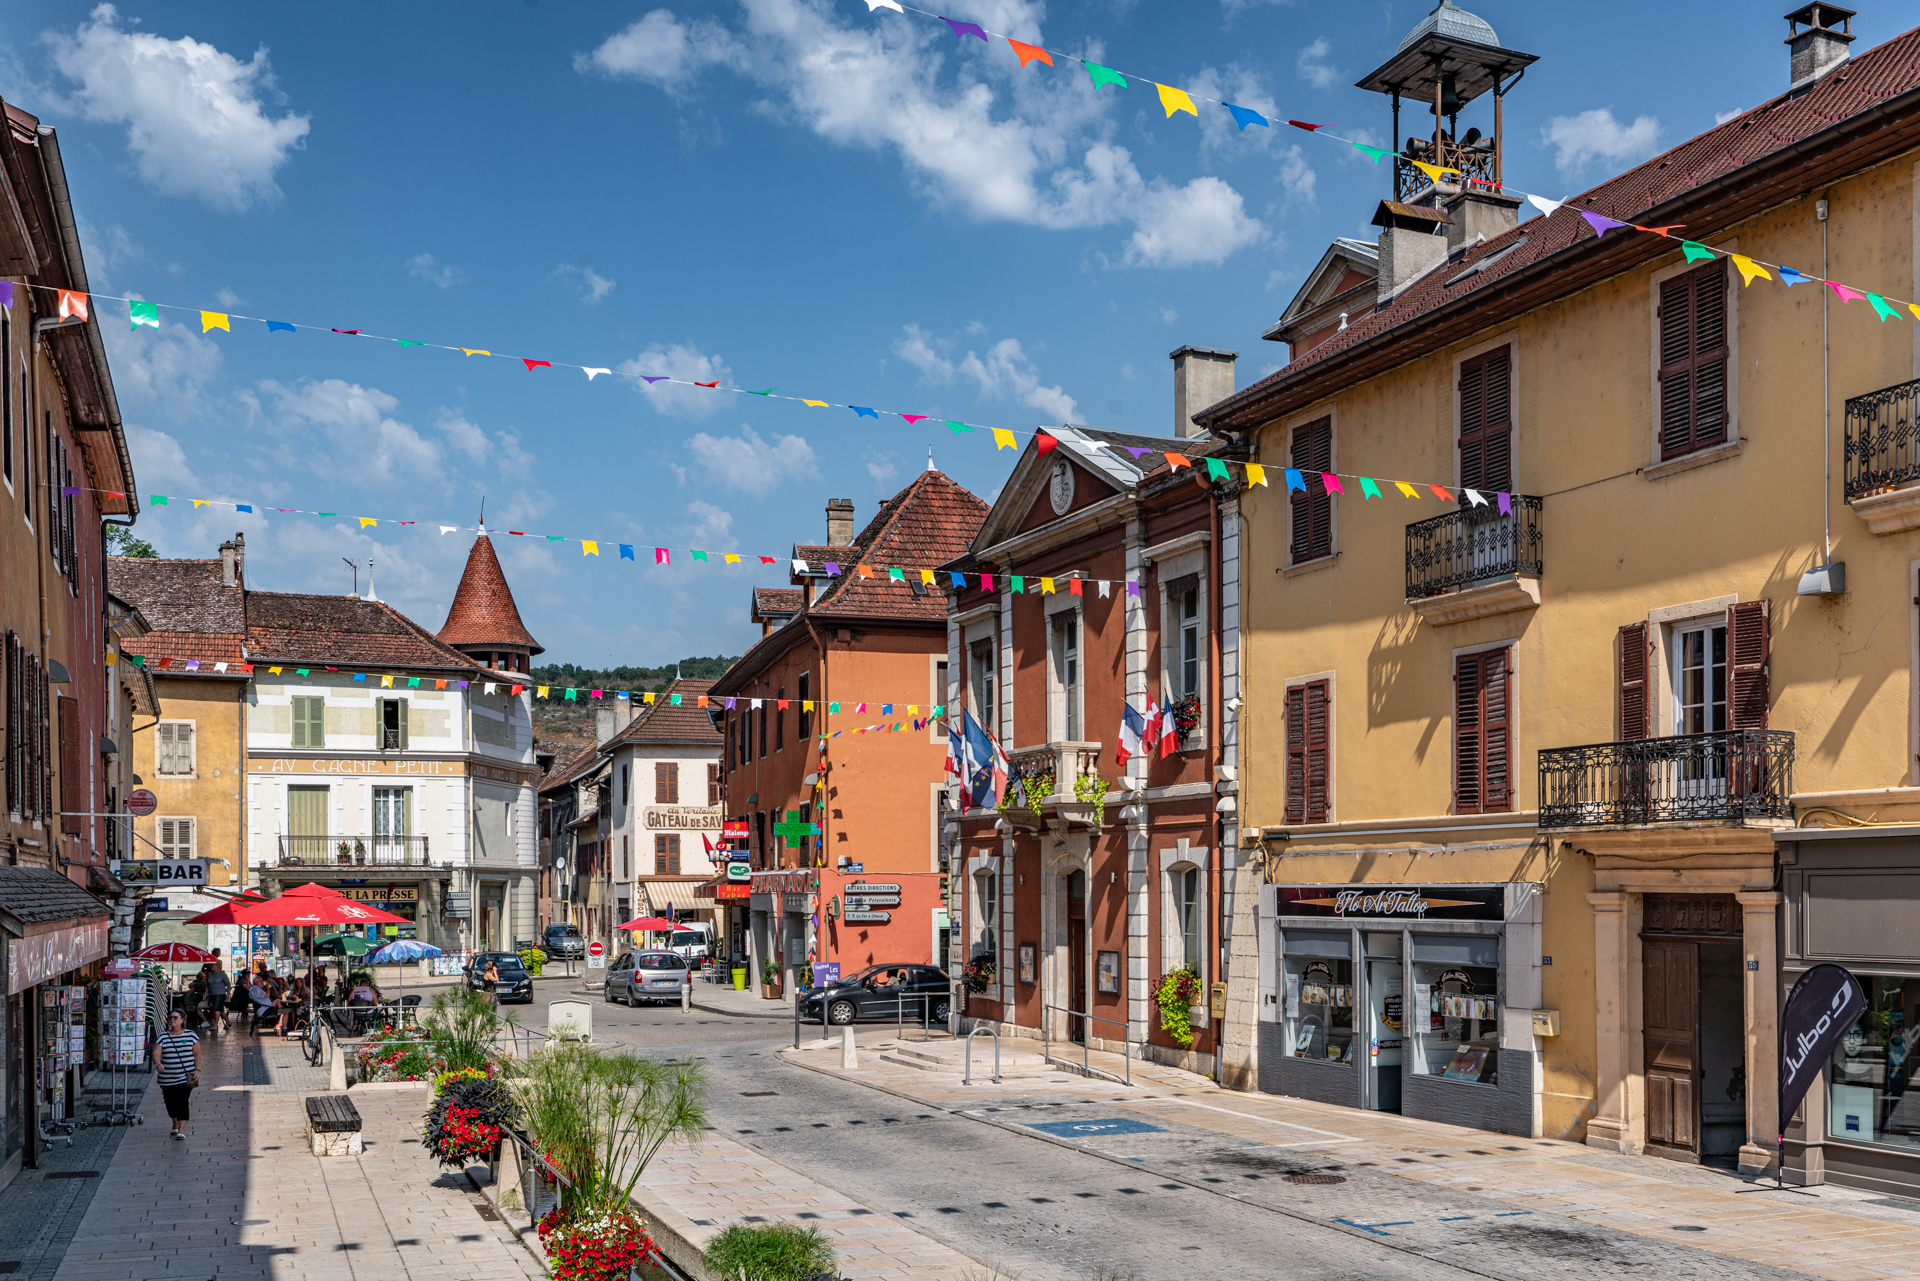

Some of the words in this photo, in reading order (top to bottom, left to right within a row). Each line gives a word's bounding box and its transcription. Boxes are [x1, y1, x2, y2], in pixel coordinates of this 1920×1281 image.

[312, 760, 380, 773] GAGNE
[394, 761, 442, 774] PETIT
[159, 865, 202, 879] BAR
[755, 874, 814, 892] PHARMACIE
[356, 890, 369, 899] LA
[372, 890, 414, 899] PRESSE
[1787, 1014, 1832, 1086] Julbo
